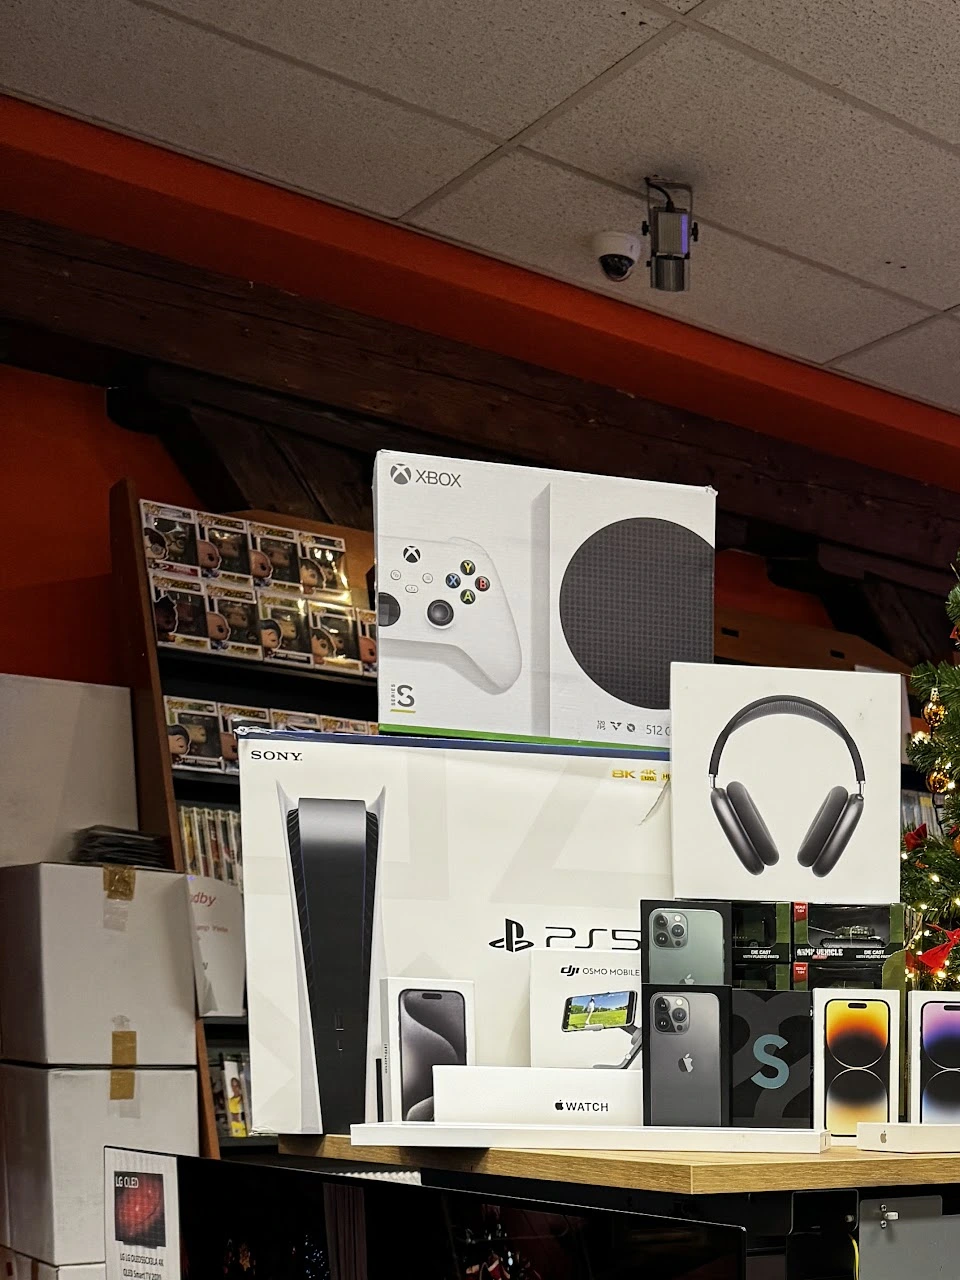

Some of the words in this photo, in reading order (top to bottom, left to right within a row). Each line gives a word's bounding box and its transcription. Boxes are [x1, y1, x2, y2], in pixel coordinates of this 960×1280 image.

[416, 469, 461, 488] XBOX
[464, 562, 472, 573] Y
[449, 576, 457, 586] X
[479, 579, 487, 589] B
[463, 592, 473, 602] A
[646, 725, 663, 736] 512
[251, 750, 301, 761] SONY
[612, 770, 636, 779] 8K
[545, 926, 642, 950] PS5
[582, 968, 608, 976] OSMO
[609, 968, 640, 977] MOBILE
[565, 1102, 609, 1112] WATCH
[116, 1175, 123, 1187] LG
[124, 1176, 139, 1189] OLED
[133, 1270, 145, 1280] Smart
